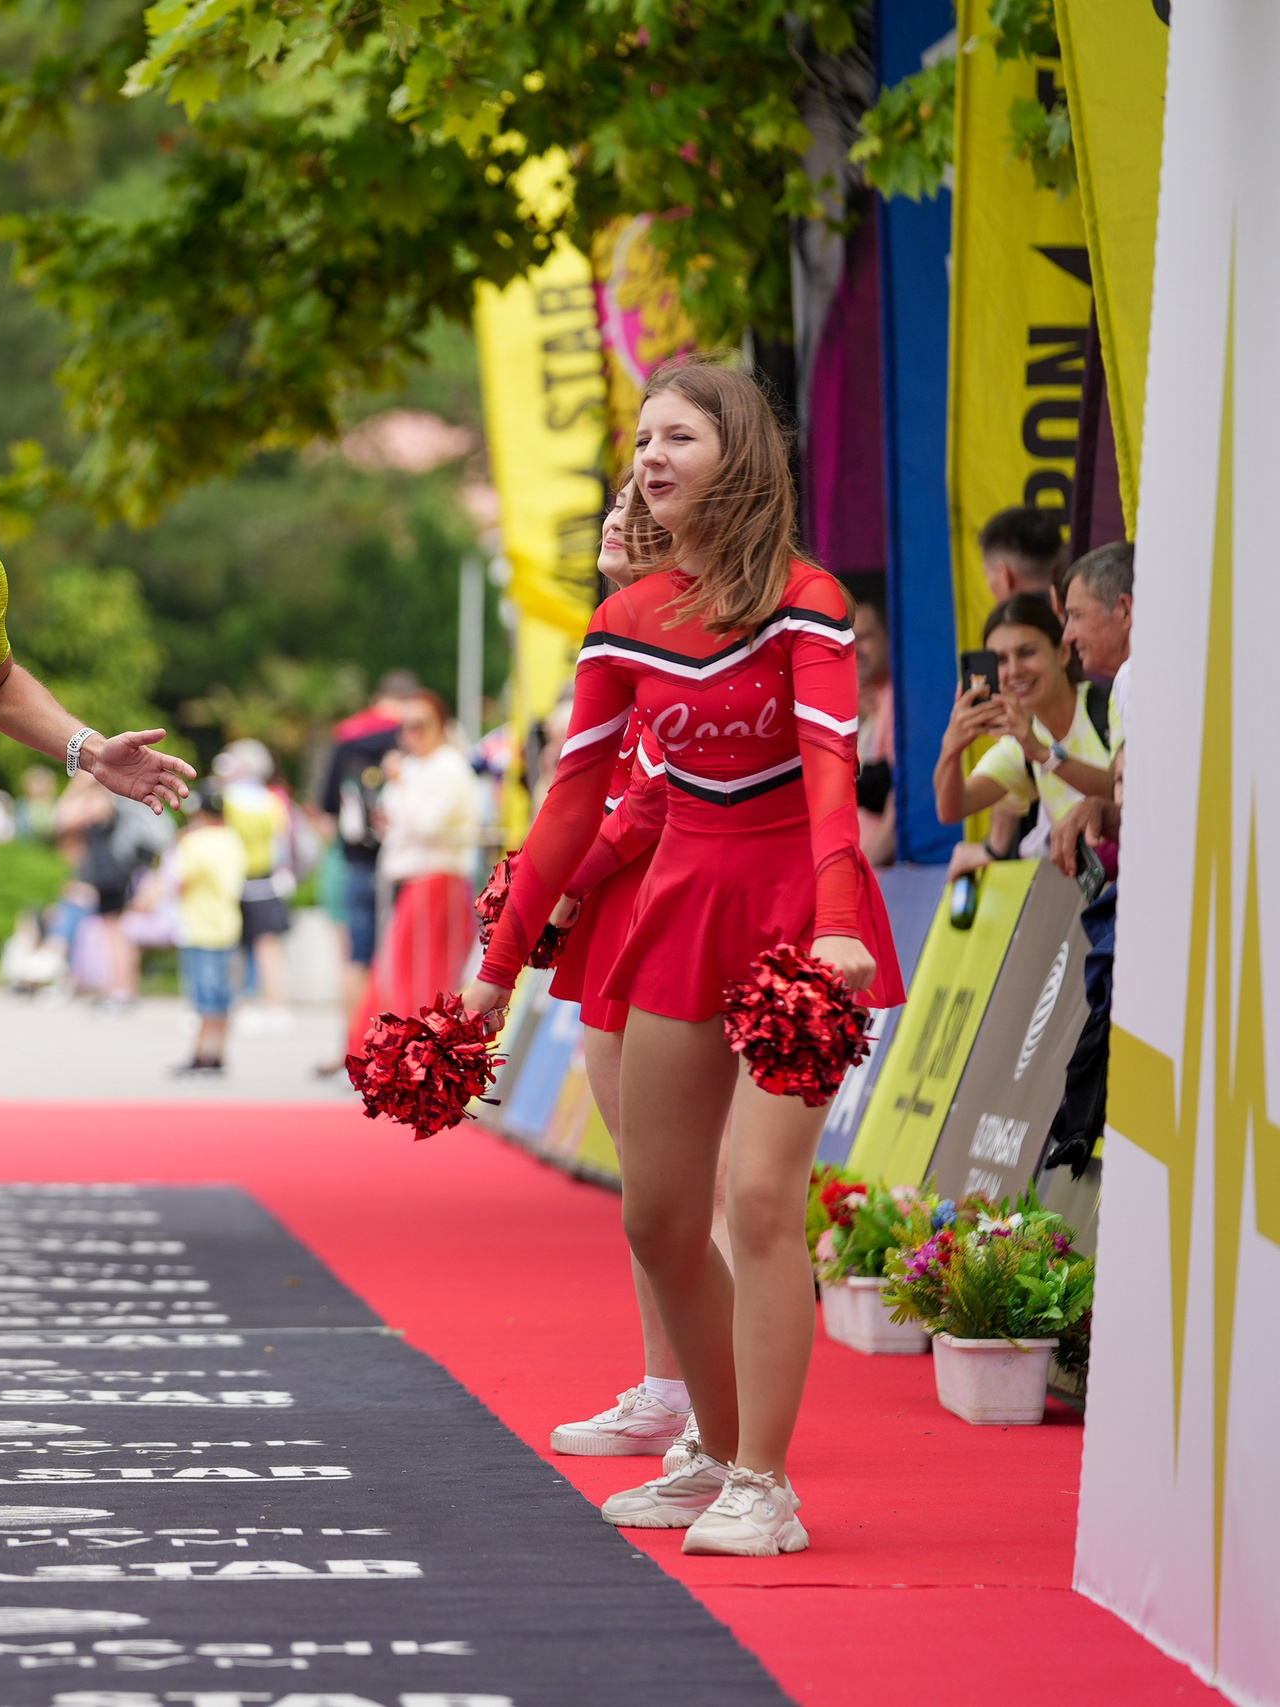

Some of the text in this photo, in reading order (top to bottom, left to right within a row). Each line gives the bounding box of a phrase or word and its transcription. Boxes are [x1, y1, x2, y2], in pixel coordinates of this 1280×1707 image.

[536, 281, 608, 430] STAR
[1022, 327, 1090, 526] RON
[651, 696, 781, 752] Cool
[0, 1389, 294, 1403] STAR
[16, 1465, 354, 1479] STAR
[34, 1560, 423, 1577] STAR
[52, 1690, 516, 1707] STAR
